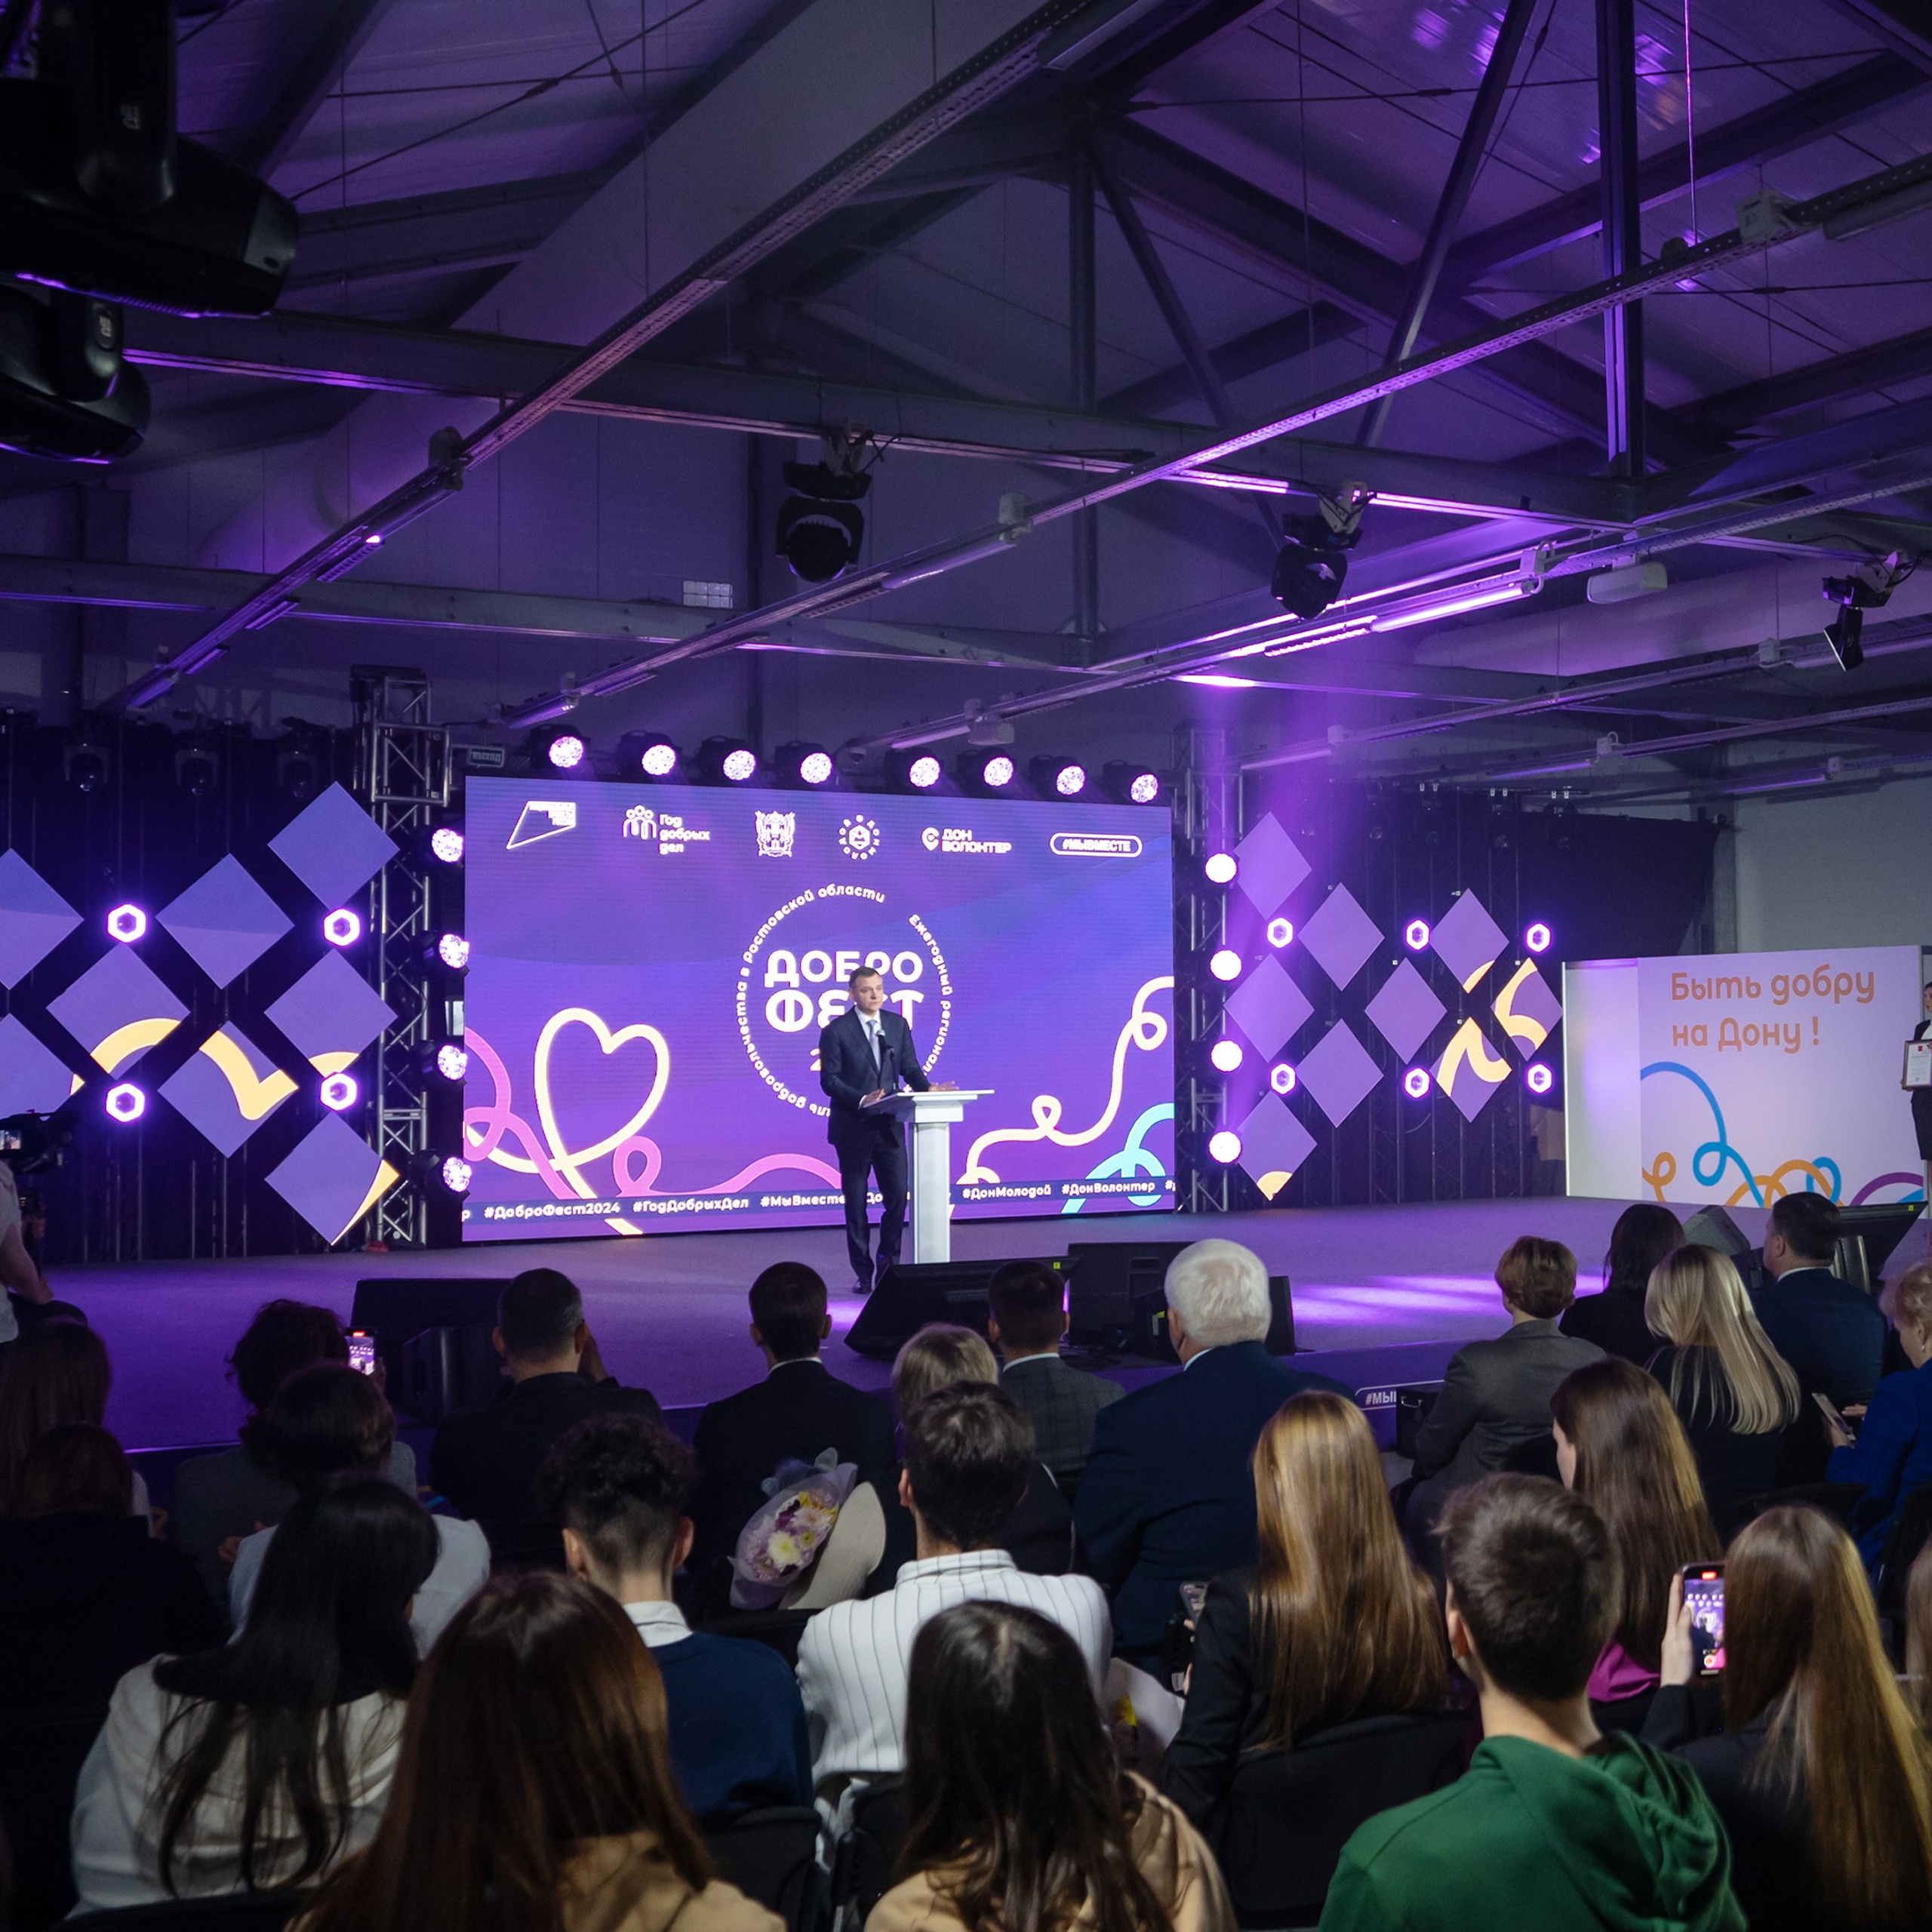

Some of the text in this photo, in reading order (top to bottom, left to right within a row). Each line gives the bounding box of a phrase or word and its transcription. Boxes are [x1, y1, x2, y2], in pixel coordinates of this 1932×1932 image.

[472, 752, 501, 762] ВЫХОД
[660, 814, 682, 828] Год
[660, 827, 710, 841] добрых
[942, 829, 972, 841] ДОН
[660, 843, 684, 854] дел
[942, 841, 1012, 854] ВОЛОНТЕР
[764, 949, 924, 988] ДОБРО
[908, 914, 953, 996] Ежегодный
[736, 981, 808, 1109] добровольчества
[818, 883, 885, 903] области
[1671, 963, 1875, 1005] Быть добру
[765, 989, 924, 1032] ФЕТ
[1672, 1024, 1709, 1047] на
[1718, 1017, 1801, 1054] Дону
[632, 1197, 749, 1214] #ГодДобрыхДел
[962, 1184, 1051, 1201] #ДонМолодой
[1061, 1182, 1155, 1196] #ДонВолонтер
